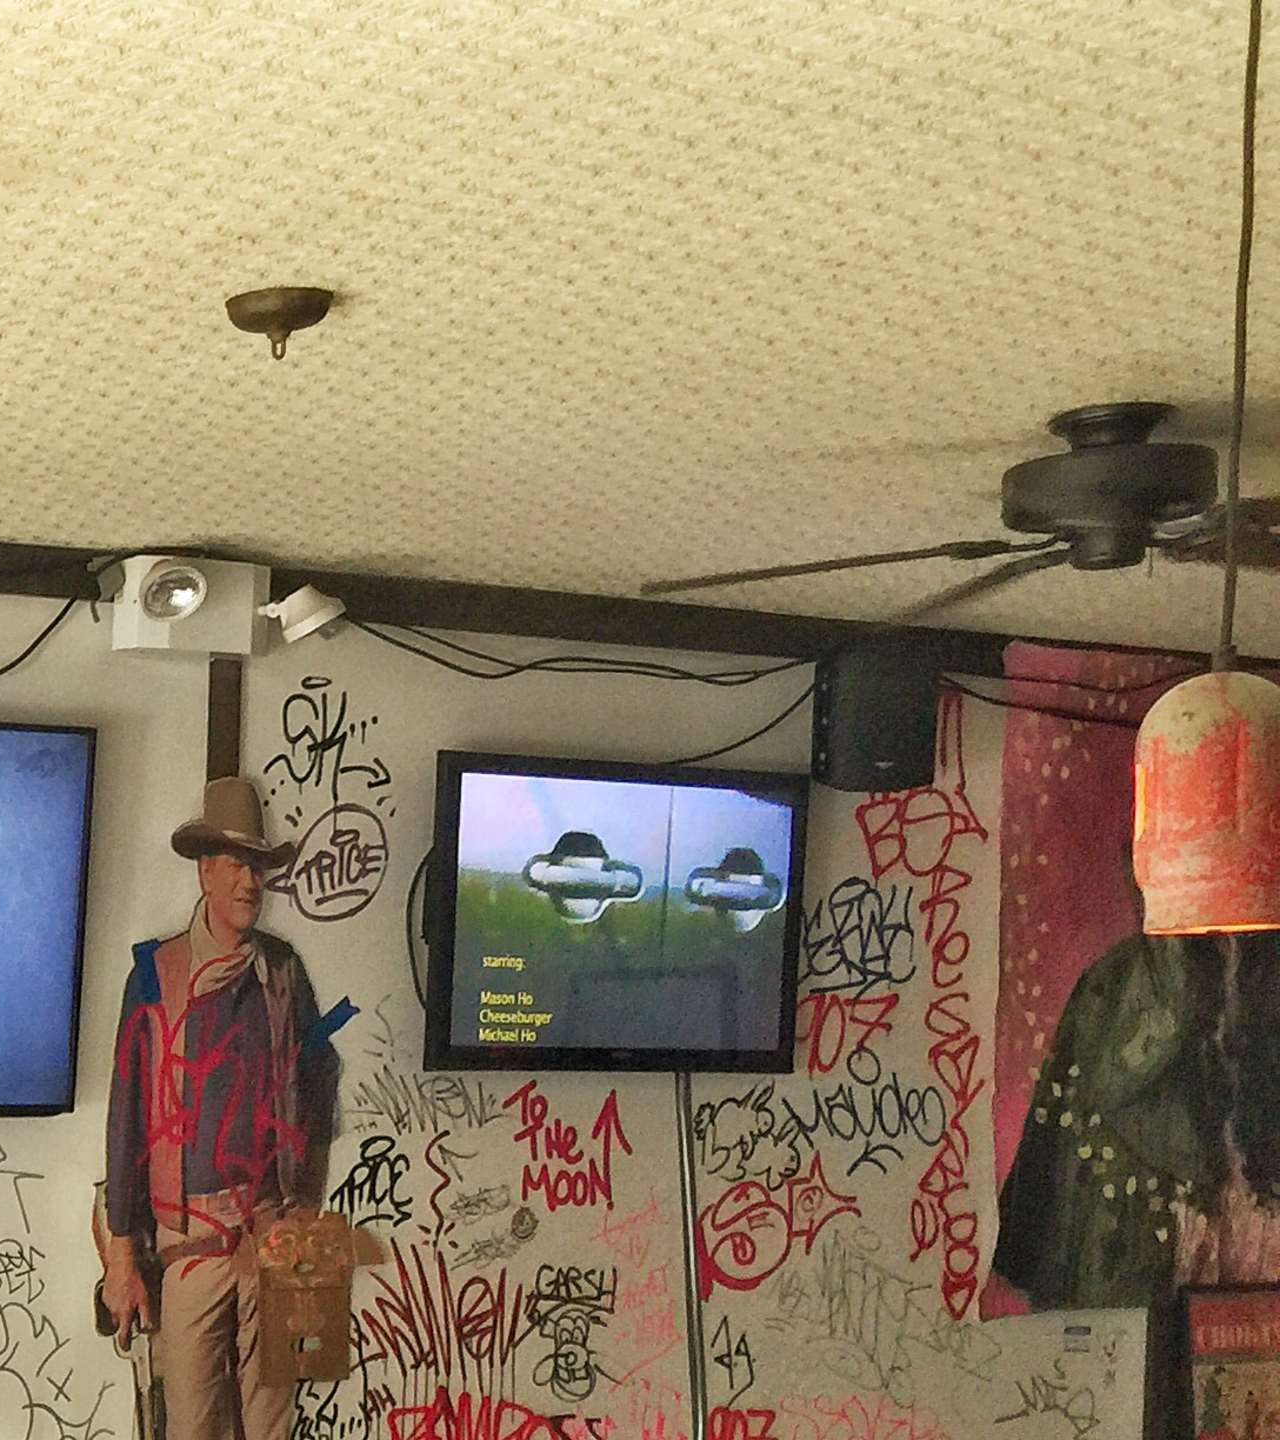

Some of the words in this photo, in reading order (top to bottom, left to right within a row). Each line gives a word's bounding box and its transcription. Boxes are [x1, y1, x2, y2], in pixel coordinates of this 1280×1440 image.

[517, 991, 534, 1006] Ho
[479, 1009, 553, 1026] Cheeseburger
[479, 1028, 519, 1042] Michael
[521, 1028, 537, 1042] Ho
